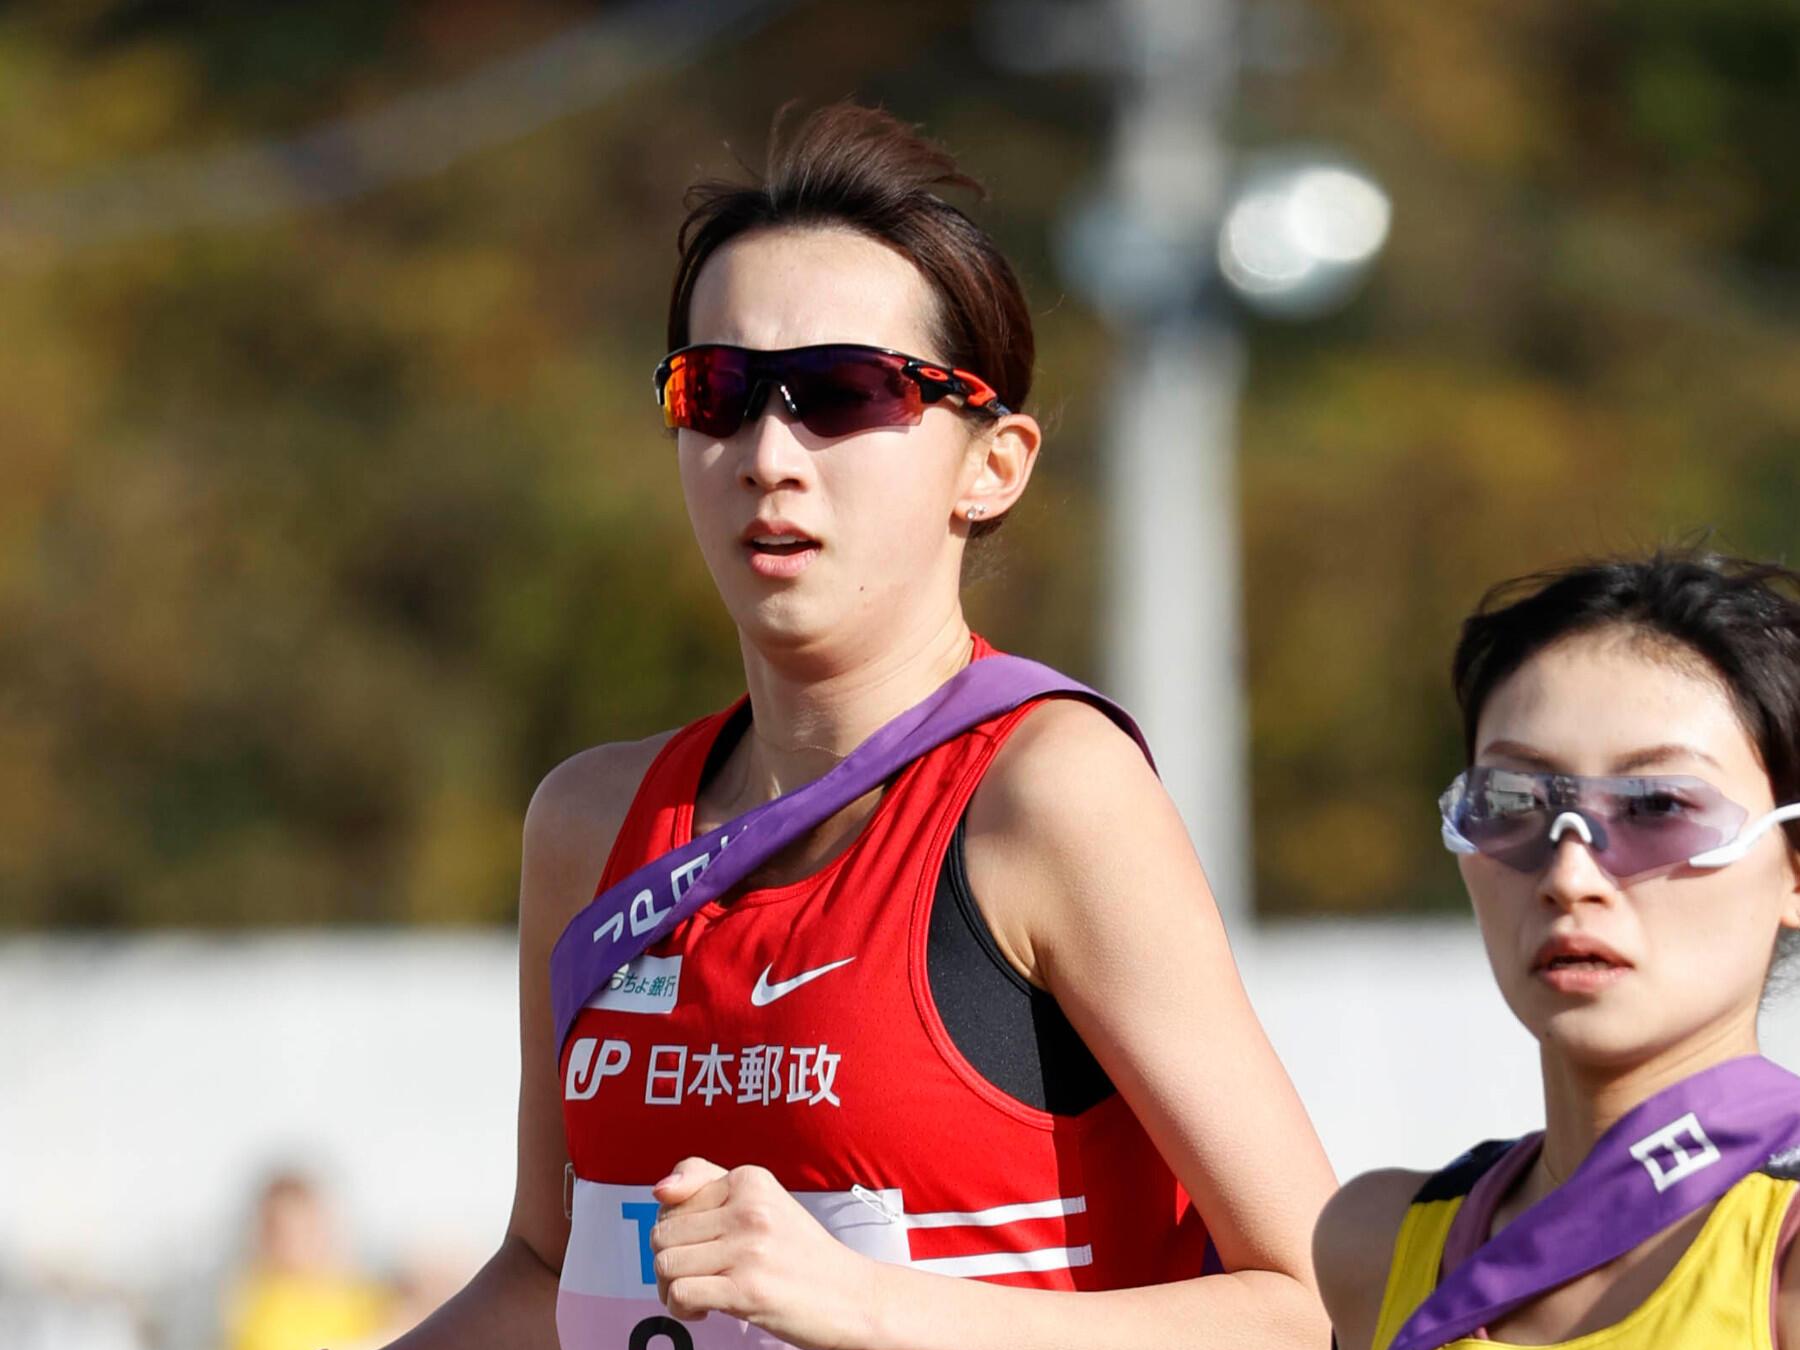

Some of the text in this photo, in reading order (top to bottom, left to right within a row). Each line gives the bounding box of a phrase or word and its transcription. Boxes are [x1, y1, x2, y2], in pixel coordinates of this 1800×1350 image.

[565, 1038, 841, 1106] JP 日本郵政
